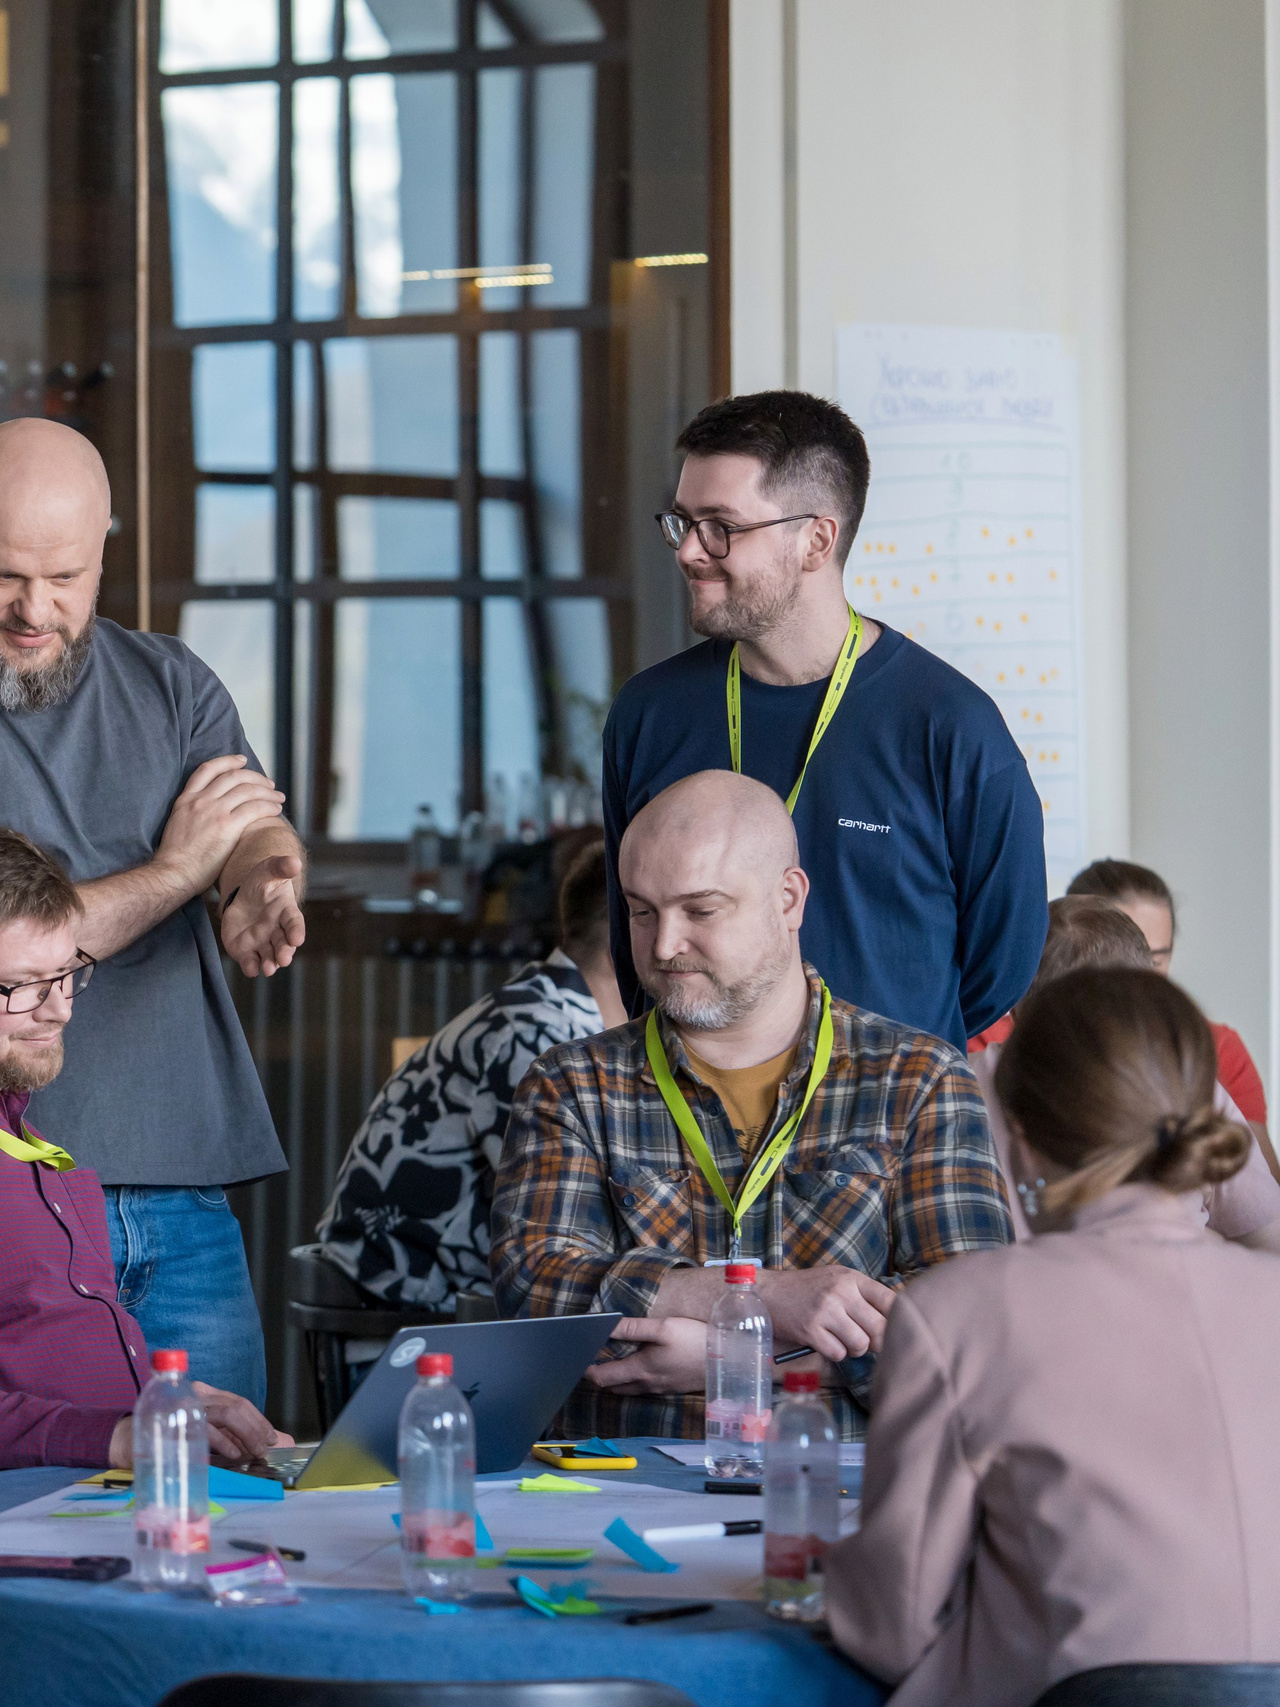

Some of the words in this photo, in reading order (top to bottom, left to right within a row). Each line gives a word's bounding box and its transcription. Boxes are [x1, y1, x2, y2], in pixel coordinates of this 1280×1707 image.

[840, 662, 849, 679] Progress
[838, 818, 891, 833] carhartt
[747, 1177, 760, 1194] Progress
